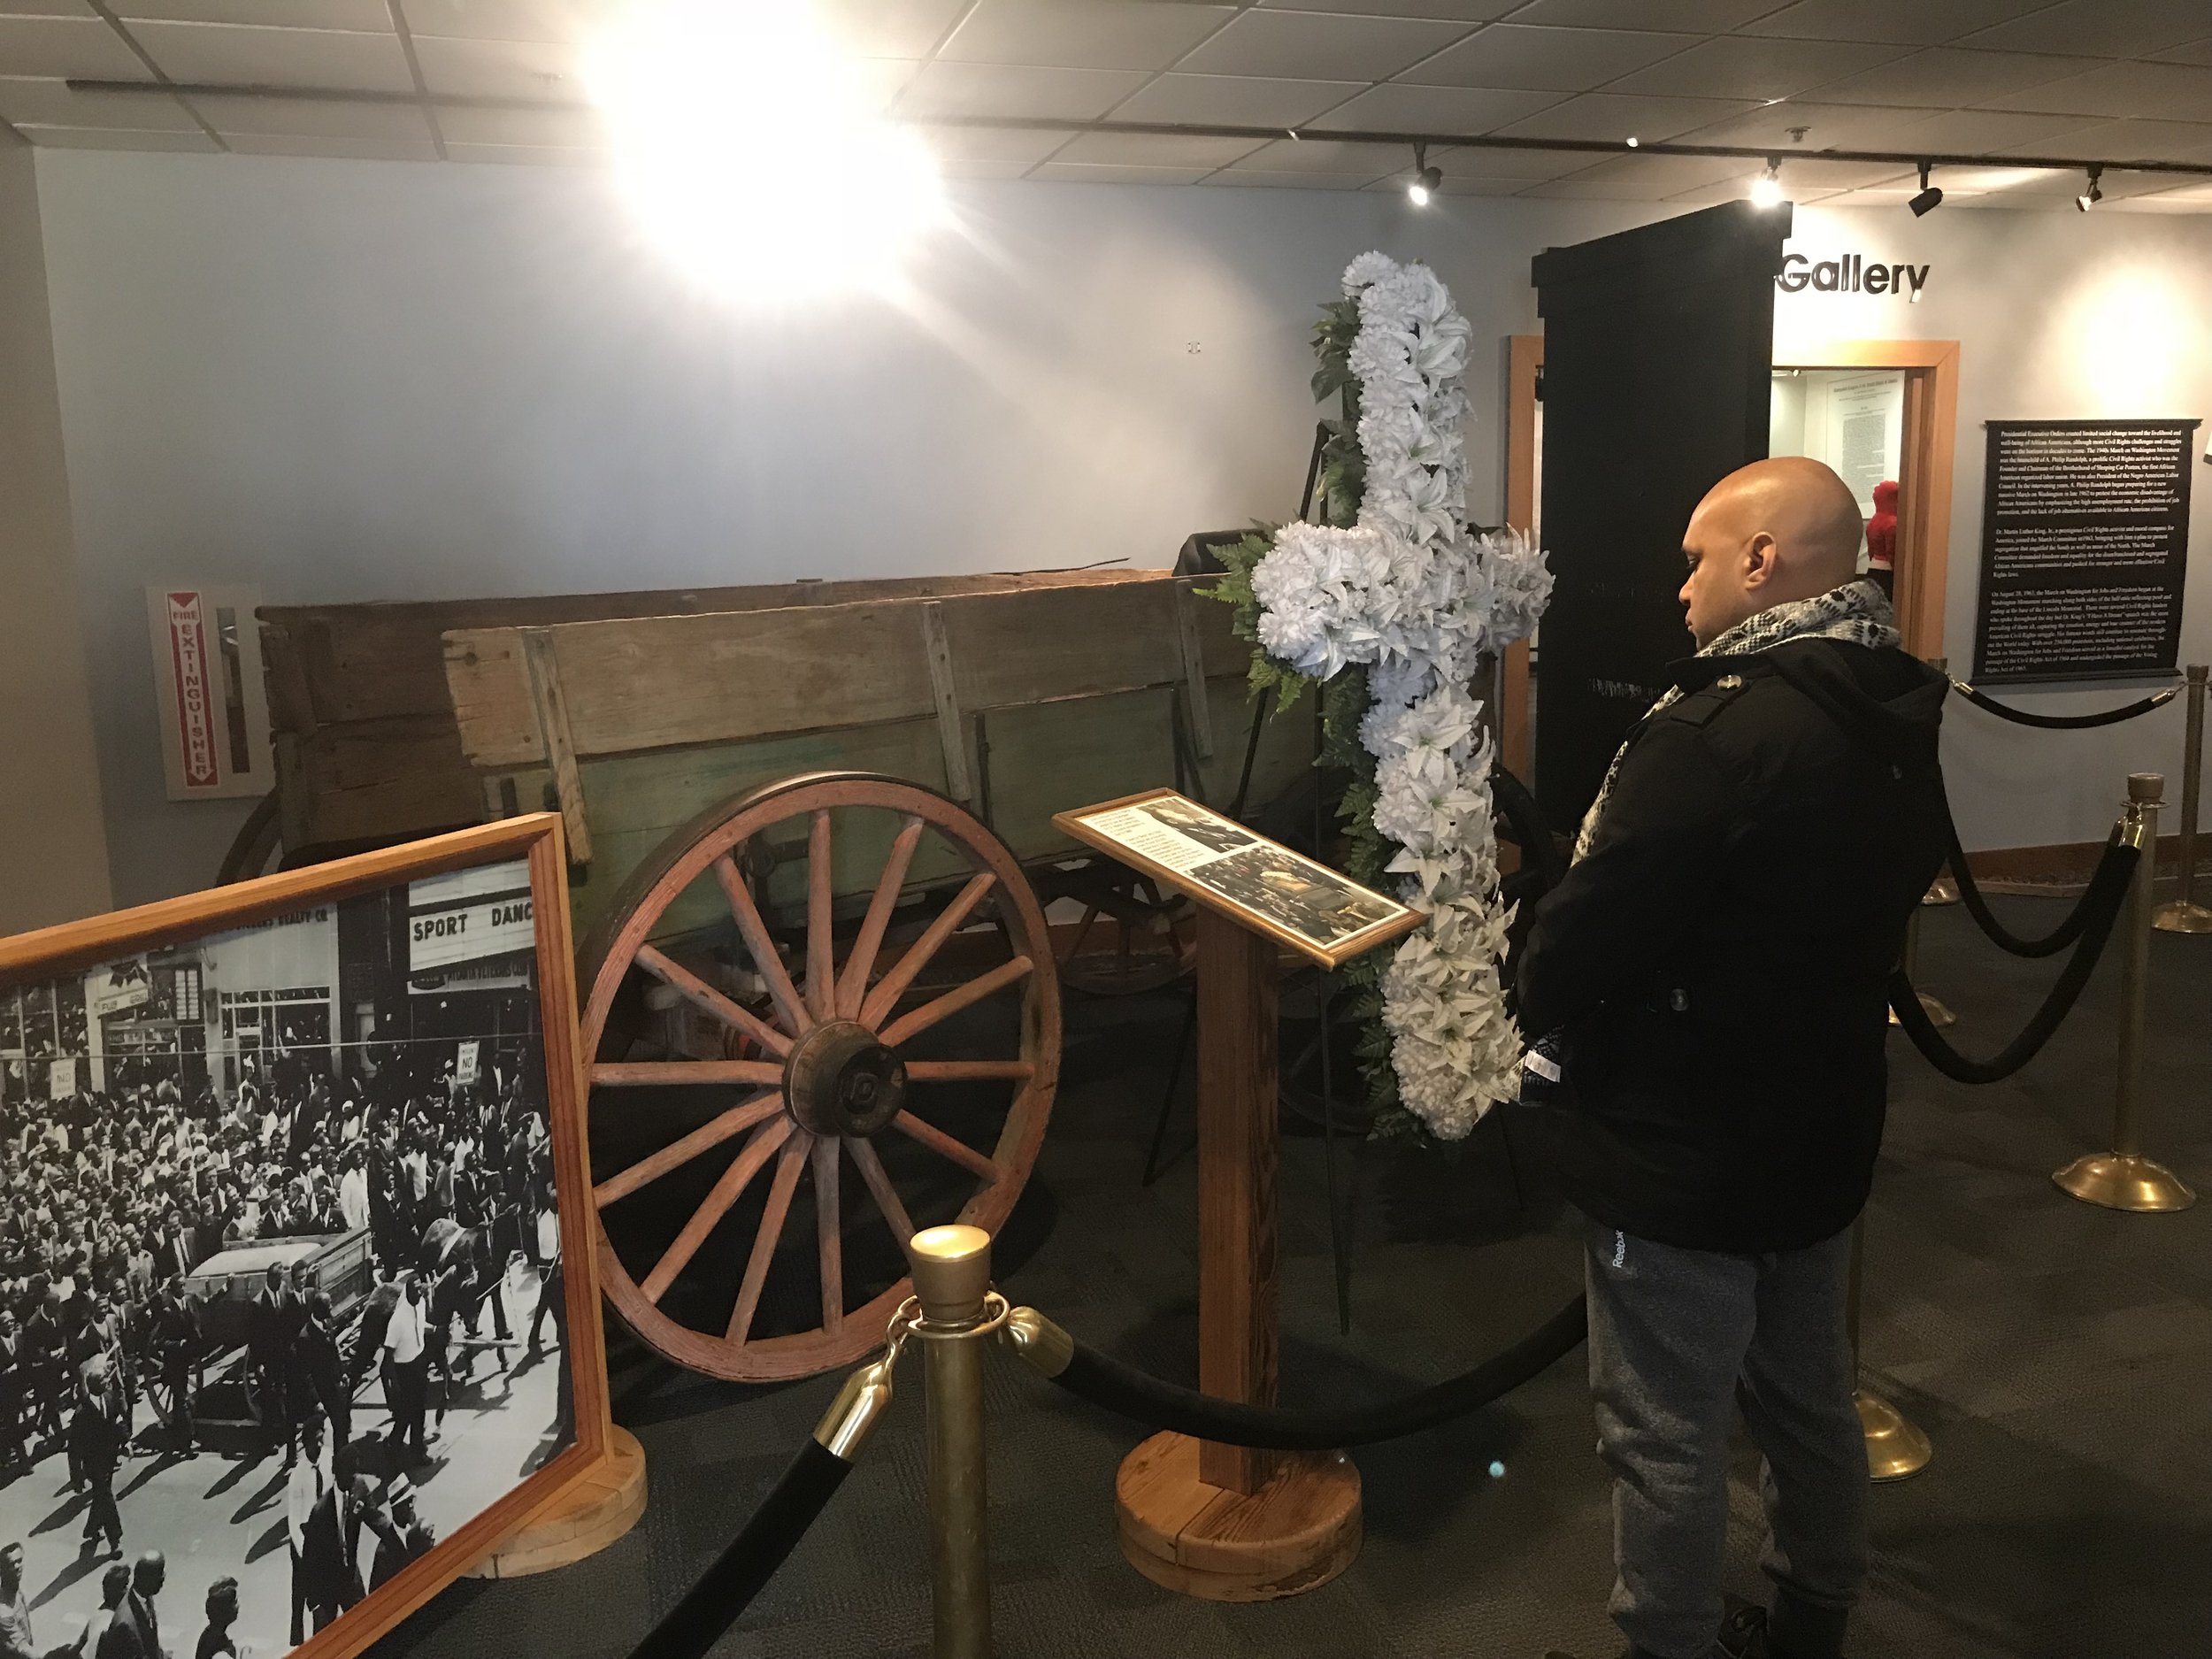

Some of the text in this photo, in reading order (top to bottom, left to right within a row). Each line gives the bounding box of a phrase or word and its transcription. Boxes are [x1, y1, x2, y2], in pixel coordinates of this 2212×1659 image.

[1775, 254, 1931, 303] Gallery
[173, 611, 197, 619] FIRE
[180, 624, 207, 775] EXTINGUISHER
[413, 914, 468, 941] SPORT
[462, 1056, 473, 1069] NO
[57, 1072, 72, 1083] NO
[1612, 1230, 1625, 1268] Reebok
